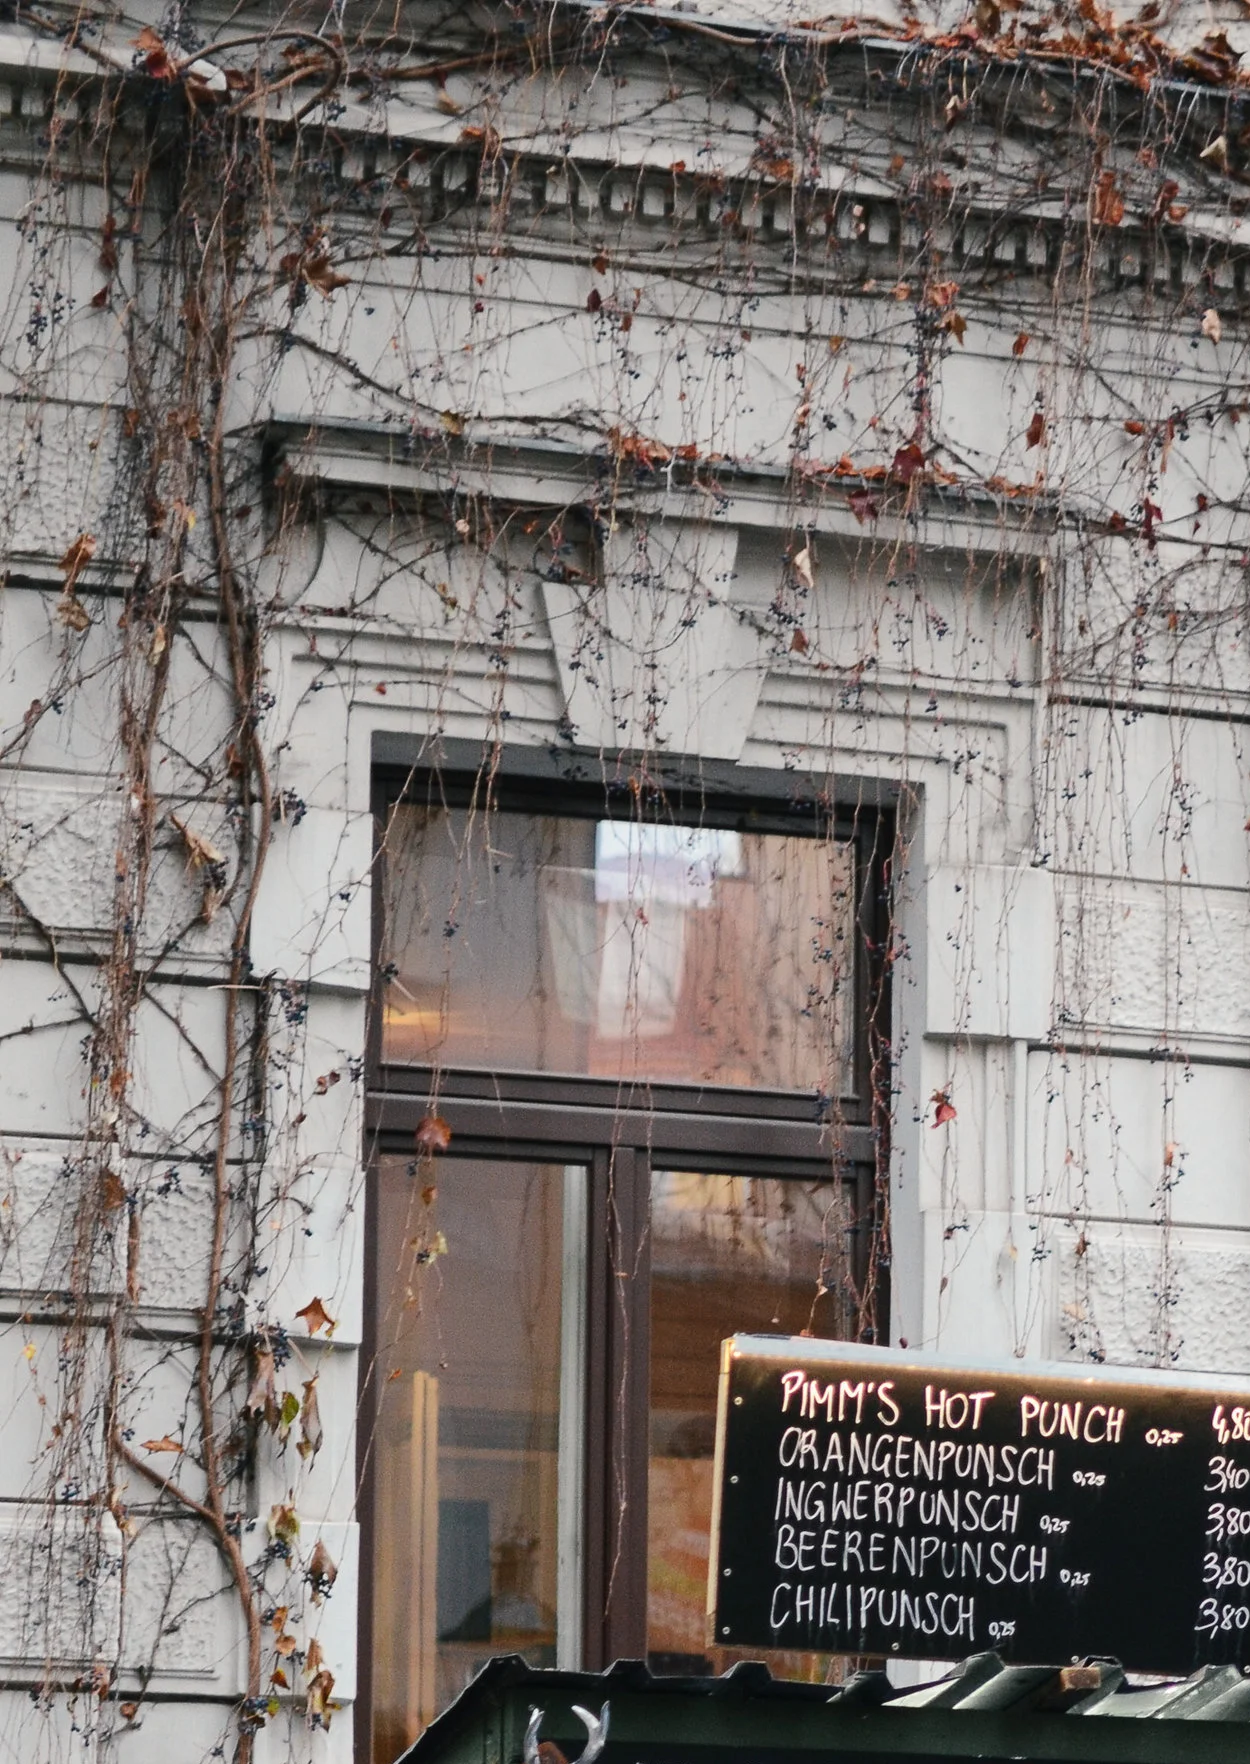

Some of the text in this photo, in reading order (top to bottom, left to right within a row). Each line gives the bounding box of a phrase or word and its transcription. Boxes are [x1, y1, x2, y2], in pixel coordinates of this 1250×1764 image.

[780, 1370, 900, 1426] PIMM'S
[926, 1385, 994, 1432] HOT
[1021, 1396, 1124, 1444] PUNCH
[779, 1426, 1055, 1490] ORANGENPUNSCH
[1204, 1456, 1250, 1491] 3,40
[775, 1479, 1021, 1532] INGWERPUNSCH
[774, 1525, 1047, 1585] BEERENPUNSCH
[770, 1584, 1250, 1640] CHILIPUNSCH 3,80
